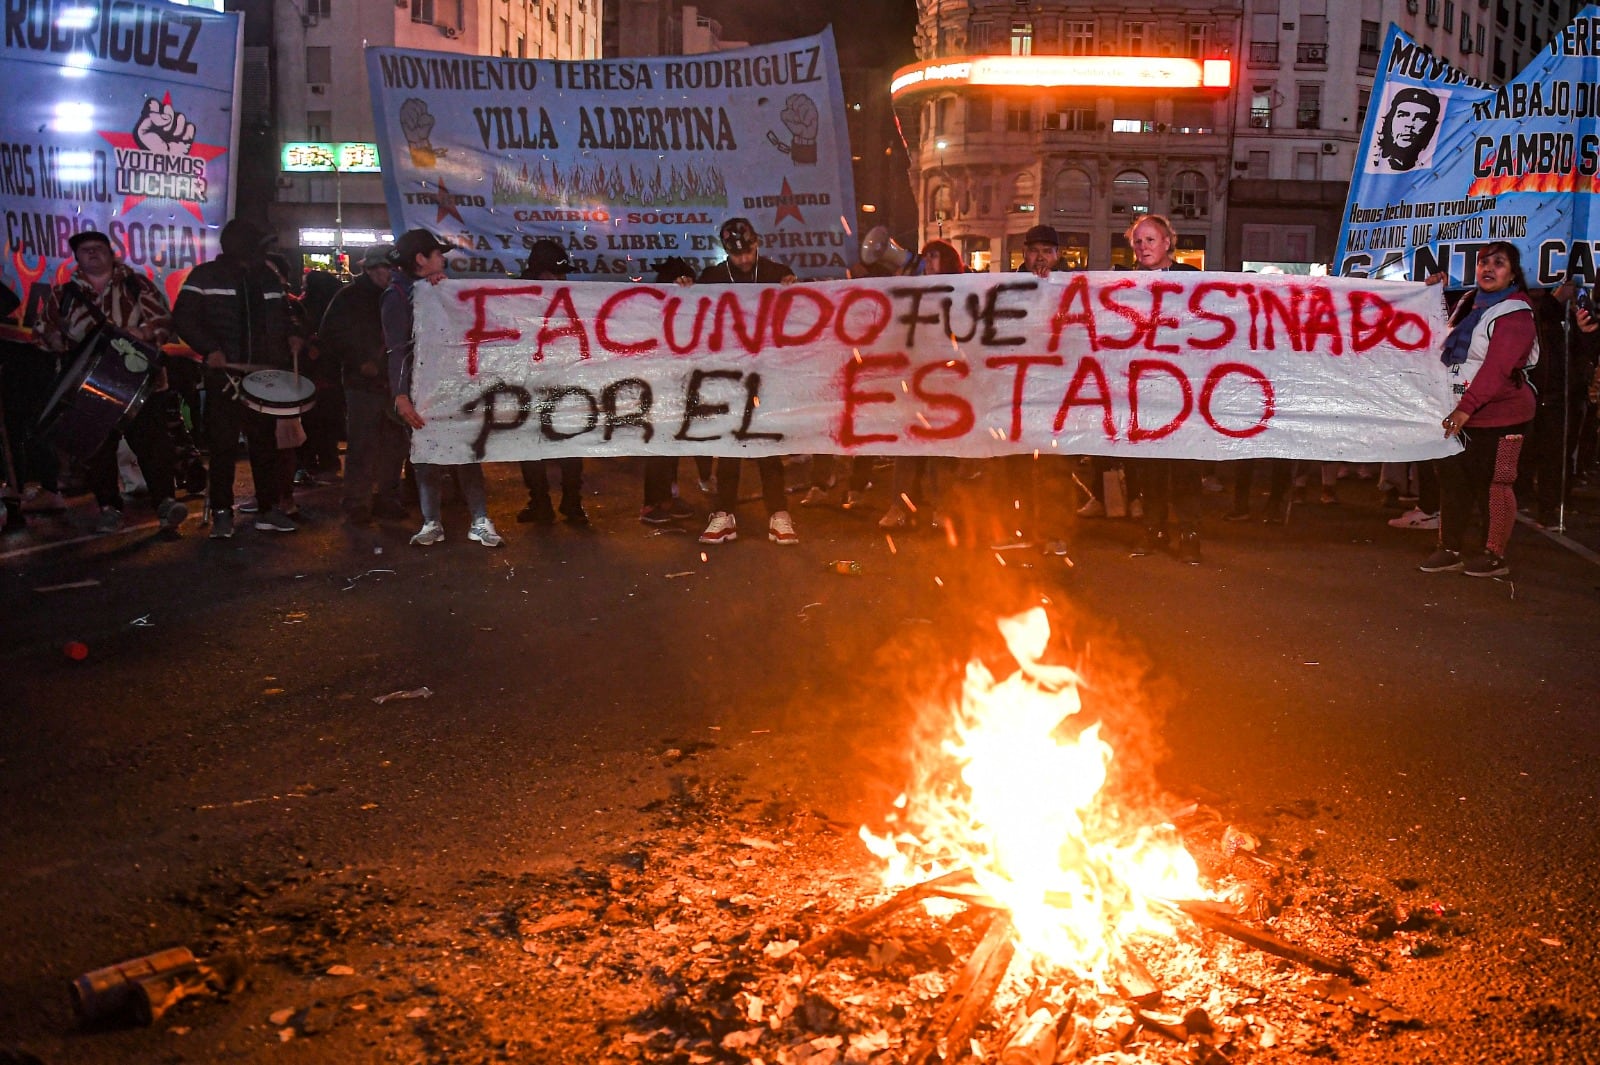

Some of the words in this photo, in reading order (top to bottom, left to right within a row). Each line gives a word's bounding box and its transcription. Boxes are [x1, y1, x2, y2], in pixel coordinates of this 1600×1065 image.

[380, 54, 537, 91] MOVIMIENTO
[553, 61, 653, 90] TERESA
[665, 46, 822, 89] RODRIGUEZ
[473, 106, 559, 150] VILLA
[578, 106, 737, 150] ALBERTINA
[117, 149, 204, 177] VOTAMOS
[1473, 133, 1574, 179] CAMBIO
[116, 167, 207, 203] LUCHAR
[743, 193, 830, 209] DIGDAD
[514, 210, 610, 222] CAMBIO
[628, 212, 712, 225] SOCIAL
[1349, 203, 1384, 223] Hemos
[1415, 202, 1435, 218] una
[6, 211, 97, 258] CAMB
[495, 234, 513, 249] Y
[606, 233, 679, 250] LIBRE
[757, 229, 845, 249] SPÍRITU
[1370, 225, 1407, 249] GRANDE
[1412, 223, 1432, 247] QUE
[1437, 217, 1484, 241] NOSOTROS
[1489, 215, 1527, 239] MISMOS
[451, 257, 505, 273] CHA
[457, 286, 893, 376] FACUNDO
[889, 280, 1038, 348] FUE
[1046, 274, 1430, 355] ASESINADO
[461, 379, 654, 460] POR
[674, 369, 784, 442] EL
[838, 352, 1275, 447] ESTADO
